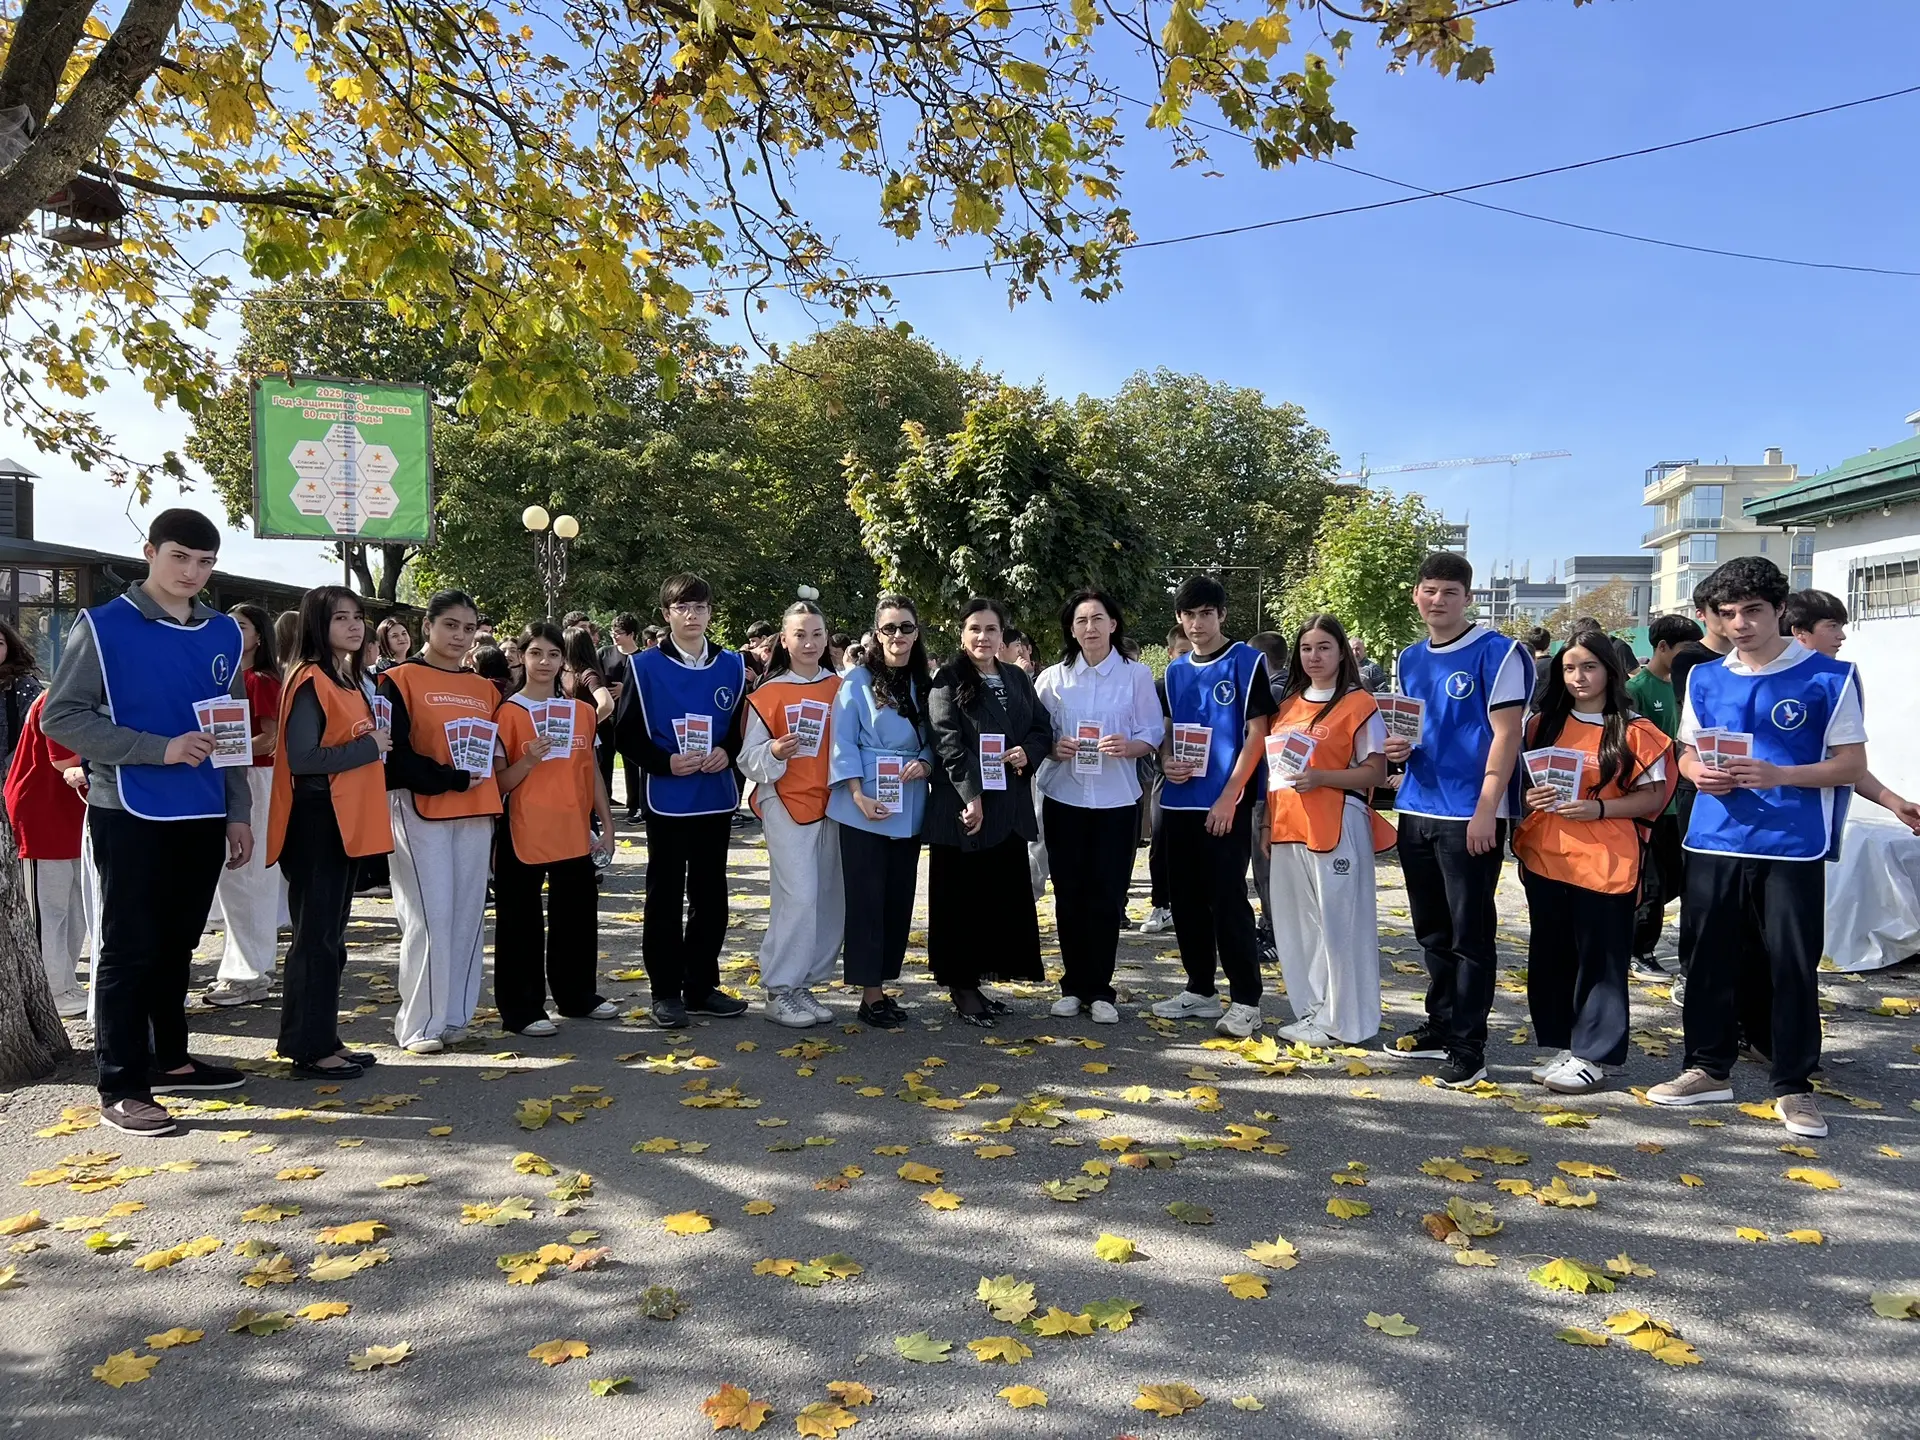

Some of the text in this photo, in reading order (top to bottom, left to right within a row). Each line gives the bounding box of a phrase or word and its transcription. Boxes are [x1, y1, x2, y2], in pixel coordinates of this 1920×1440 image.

[317, 388, 342, 398] 2025
[344, 392, 363, 401] год
[272, 395, 411, 415] Год Защитника Отечества
[303, 410, 383, 424] 80 лет Победы
